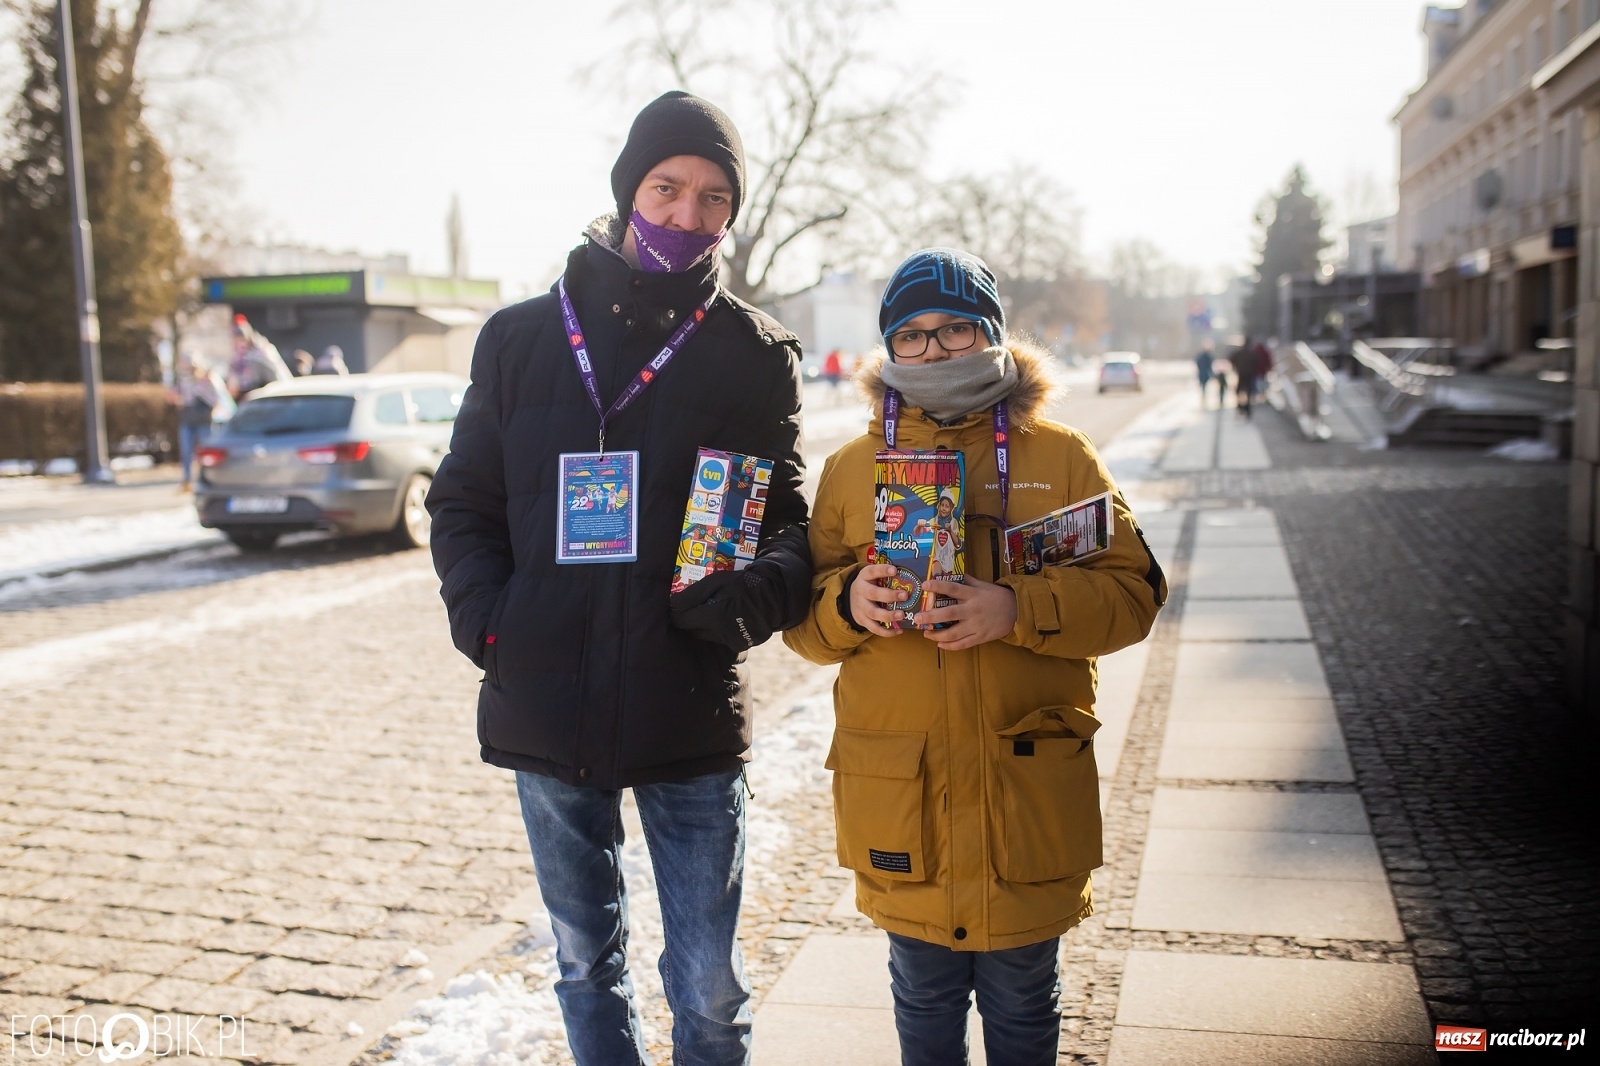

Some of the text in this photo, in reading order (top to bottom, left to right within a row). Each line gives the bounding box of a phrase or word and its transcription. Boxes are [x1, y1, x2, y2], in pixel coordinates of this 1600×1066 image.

[579, 351, 588, 370] PLAY
[653, 348, 670, 367] PLAY
[703, 467, 721, 481] tvn
[1012, 482, 1051, 490] EXP-R95
[585, 541, 627, 550] WYGRYWAMY
[735, 617, 752, 641] viking
